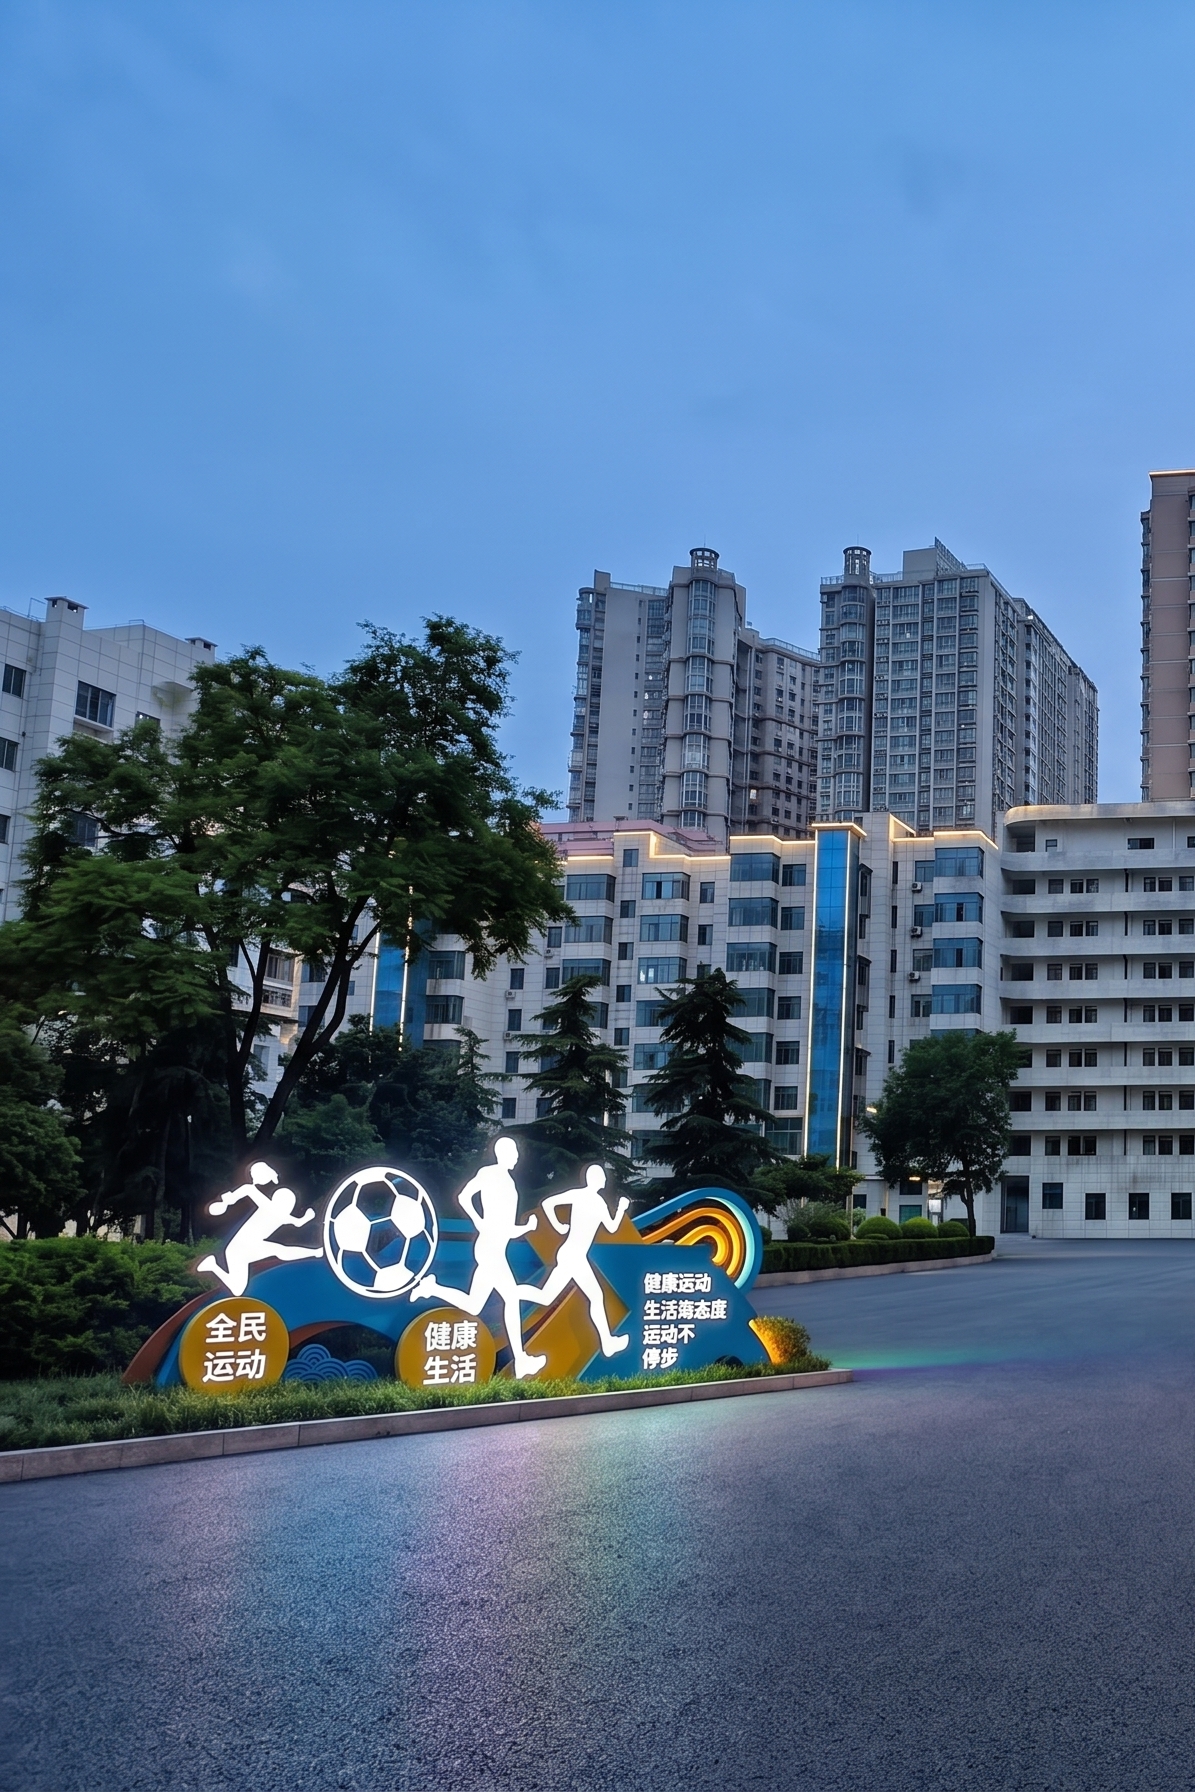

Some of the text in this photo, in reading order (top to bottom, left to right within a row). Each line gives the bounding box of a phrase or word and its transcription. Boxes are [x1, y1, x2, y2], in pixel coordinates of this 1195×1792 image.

[643, 1273, 712, 1294] 健康运动
[205, 1312, 267, 1343] 全民
[424, 1319, 478, 1351] 健康
[642, 1324, 696, 1345] 运动不
[202, 1349, 266, 1383] 运动
[422, 1353, 477, 1386] 生活
[642, 1347, 679, 1370] 停步
